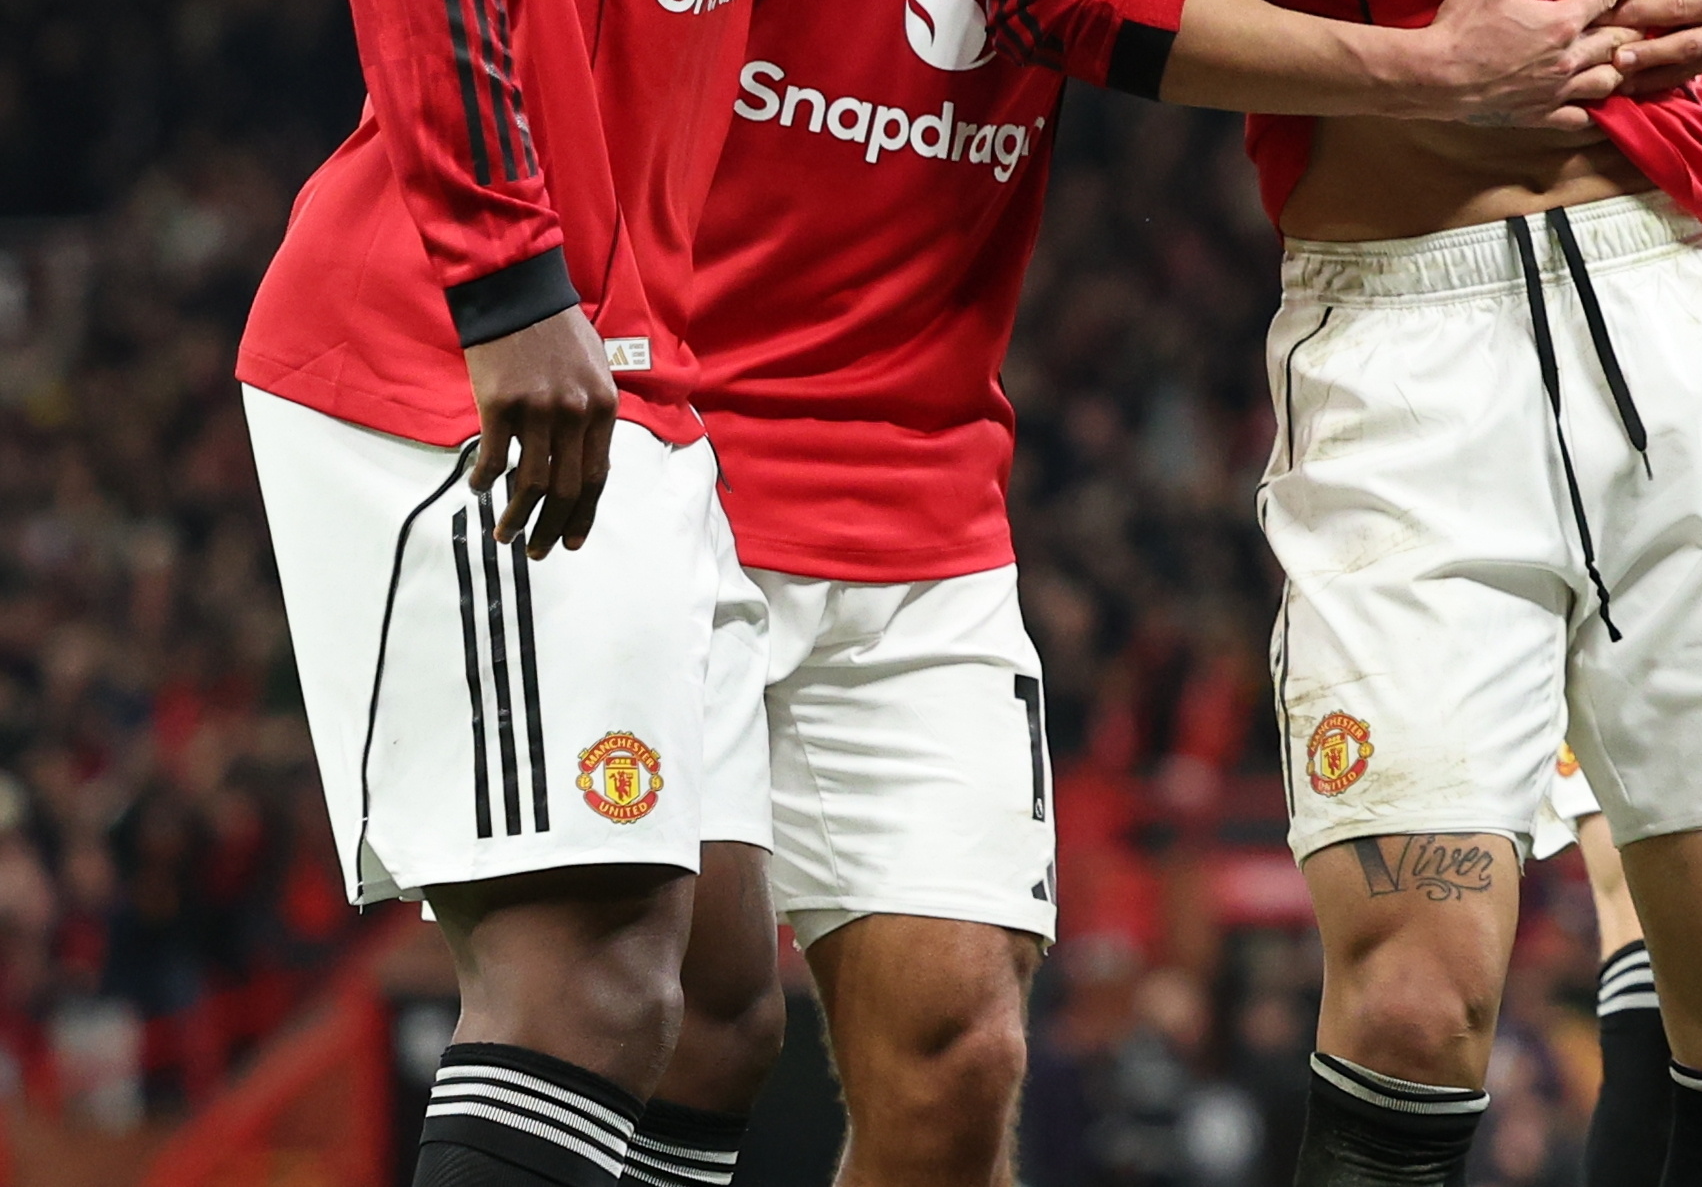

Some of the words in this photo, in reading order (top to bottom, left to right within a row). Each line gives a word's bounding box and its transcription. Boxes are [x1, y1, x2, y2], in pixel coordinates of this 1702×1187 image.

[733, 60, 1045, 183] Snapdrag
[1310, 716, 1365, 752] MANCHESTER
[584, 737, 657, 768] MANCHESTER
[598, 801, 648, 817] UNITED
